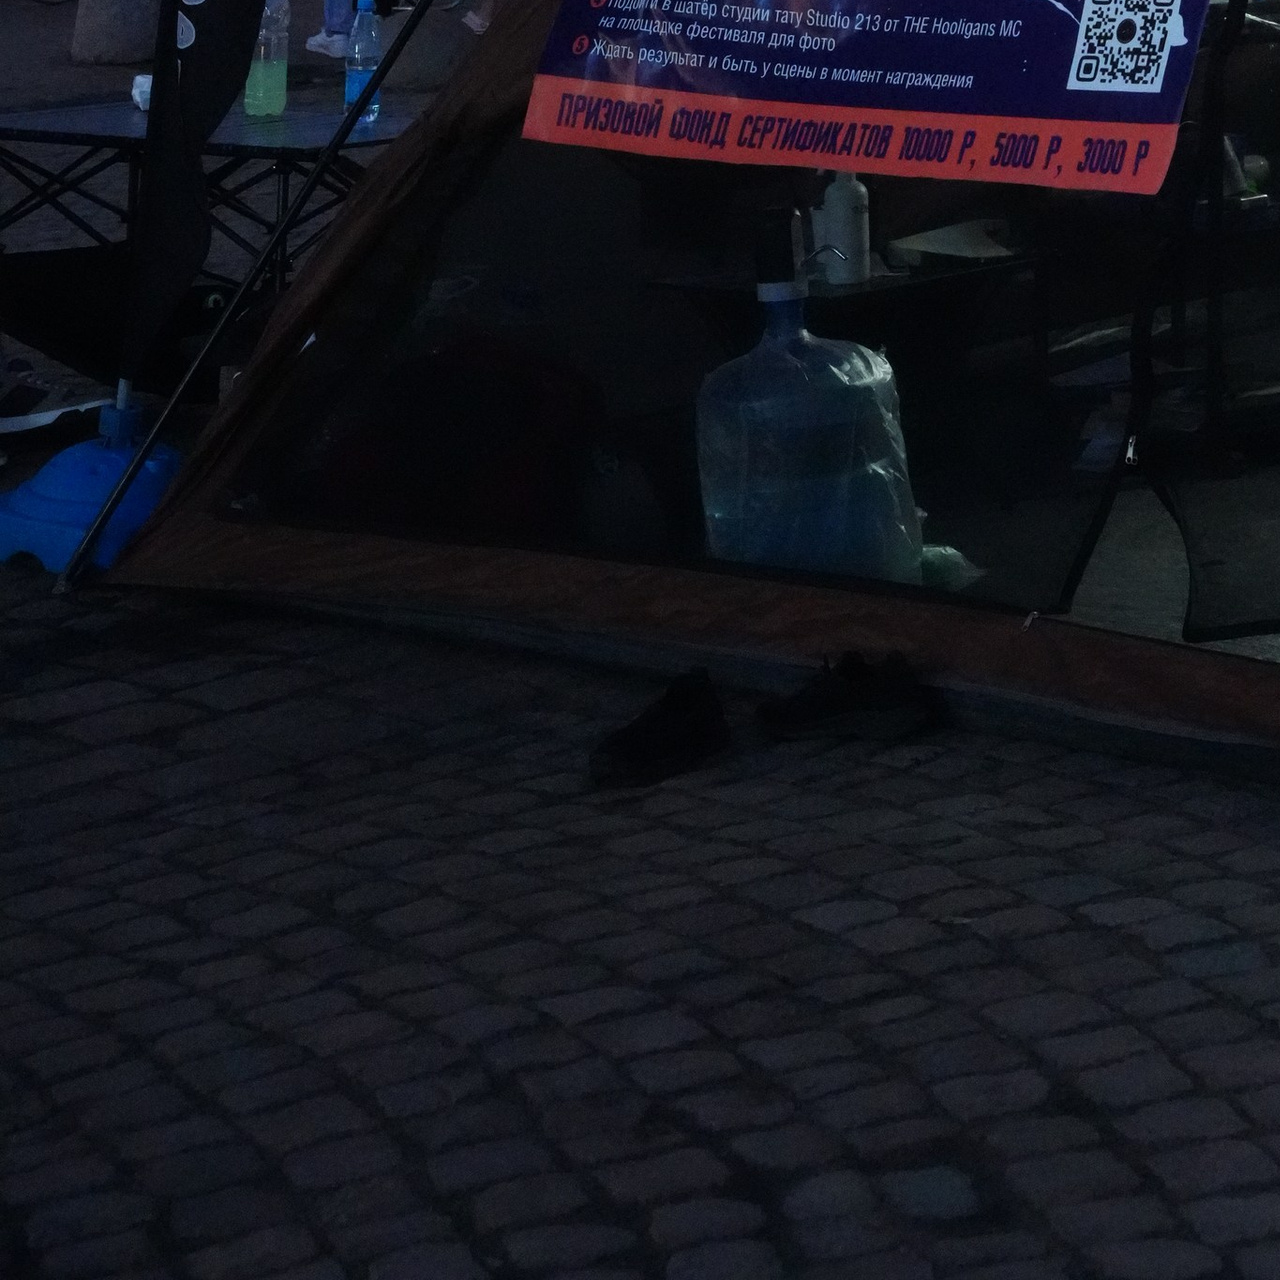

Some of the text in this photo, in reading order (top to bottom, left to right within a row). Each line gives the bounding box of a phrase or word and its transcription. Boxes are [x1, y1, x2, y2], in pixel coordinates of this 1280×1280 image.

[598, 15, 836, 52] на площадке фестиваля для фото
[674, 0, 718, 18] шатёр
[721, 4, 770, 23] студии
[774, 9, 803, 28] тату
[806, 8, 851, 30] Studio
[854, 13, 881, 32] 213
[883, 18, 899, 33] от
[903, 15, 930, 34] THE
[931, 16, 996, 39] Hooligans
[999, 19, 1023, 38] MC
[590, 38, 634, 60] Ждать
[638, 47, 705, 68] результат
[708, 55, 718, 69] и
[722, 54, 758, 74] быть
[760, 61, 772, 78] у
[773, 62, 817, 80] сцены
[820, 66, 828, 80] в
[831, 67, 884, 84] момент
[885, 70, 974, 89] награждения
[556, 92, 1150, 179] ПРИЗОВОЙ ФОНД СЕРТИФИКАТОВ 10000 Р, 5000 Р, 3000 Р
